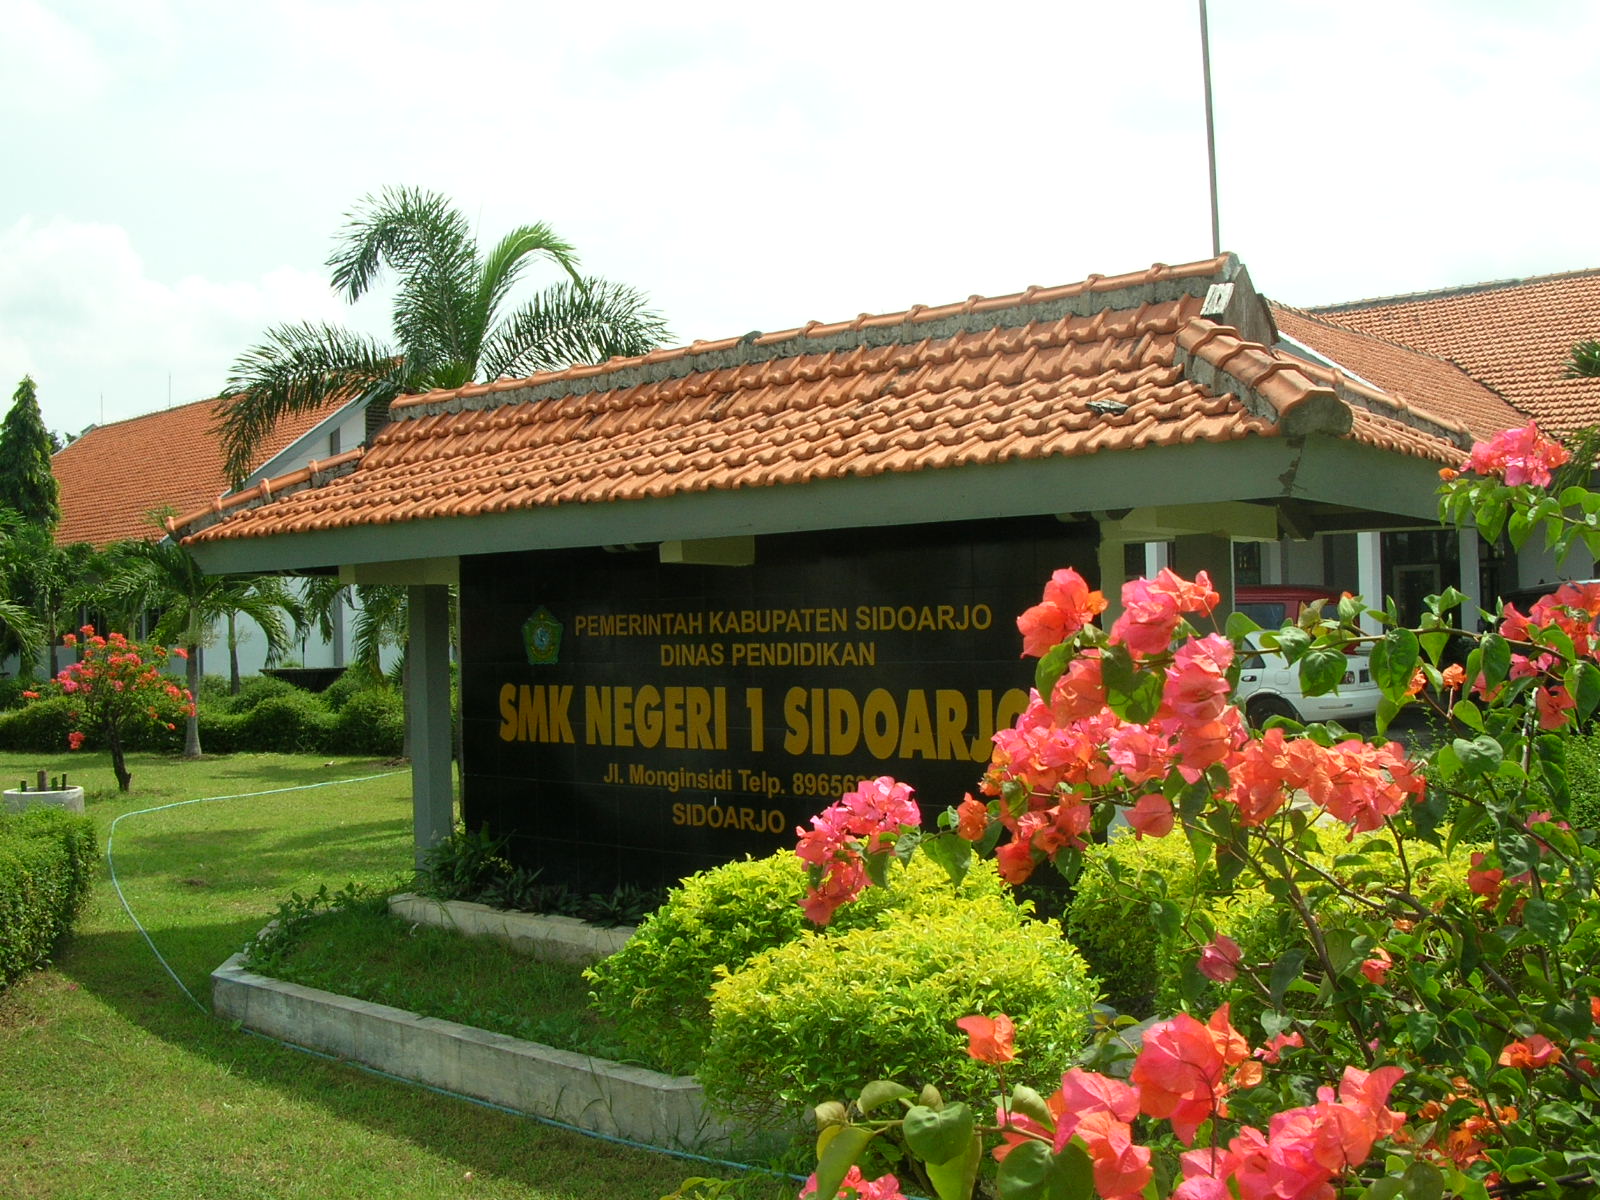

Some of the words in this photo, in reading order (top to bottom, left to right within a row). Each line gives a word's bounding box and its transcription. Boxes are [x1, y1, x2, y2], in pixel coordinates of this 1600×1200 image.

[575, 613, 702, 636] PEMERINTAH
[709, 608, 848, 633] KABUPATEN
[855, 604, 992, 631] SIDOARJO
[660, 643, 724, 666] DINAS
[732, 642, 875, 666] PENDIDIKAN
[499, 683, 575, 744] SMK
[585, 685, 728, 750] NEGERI
[746, 687, 764, 752] 1
[629, 764, 732, 792] Monginsidi
[738, 769, 786, 799] Telp.
[793, 773, 879, 797] 89656
[673, 803, 785, 833] SIDOARJO
